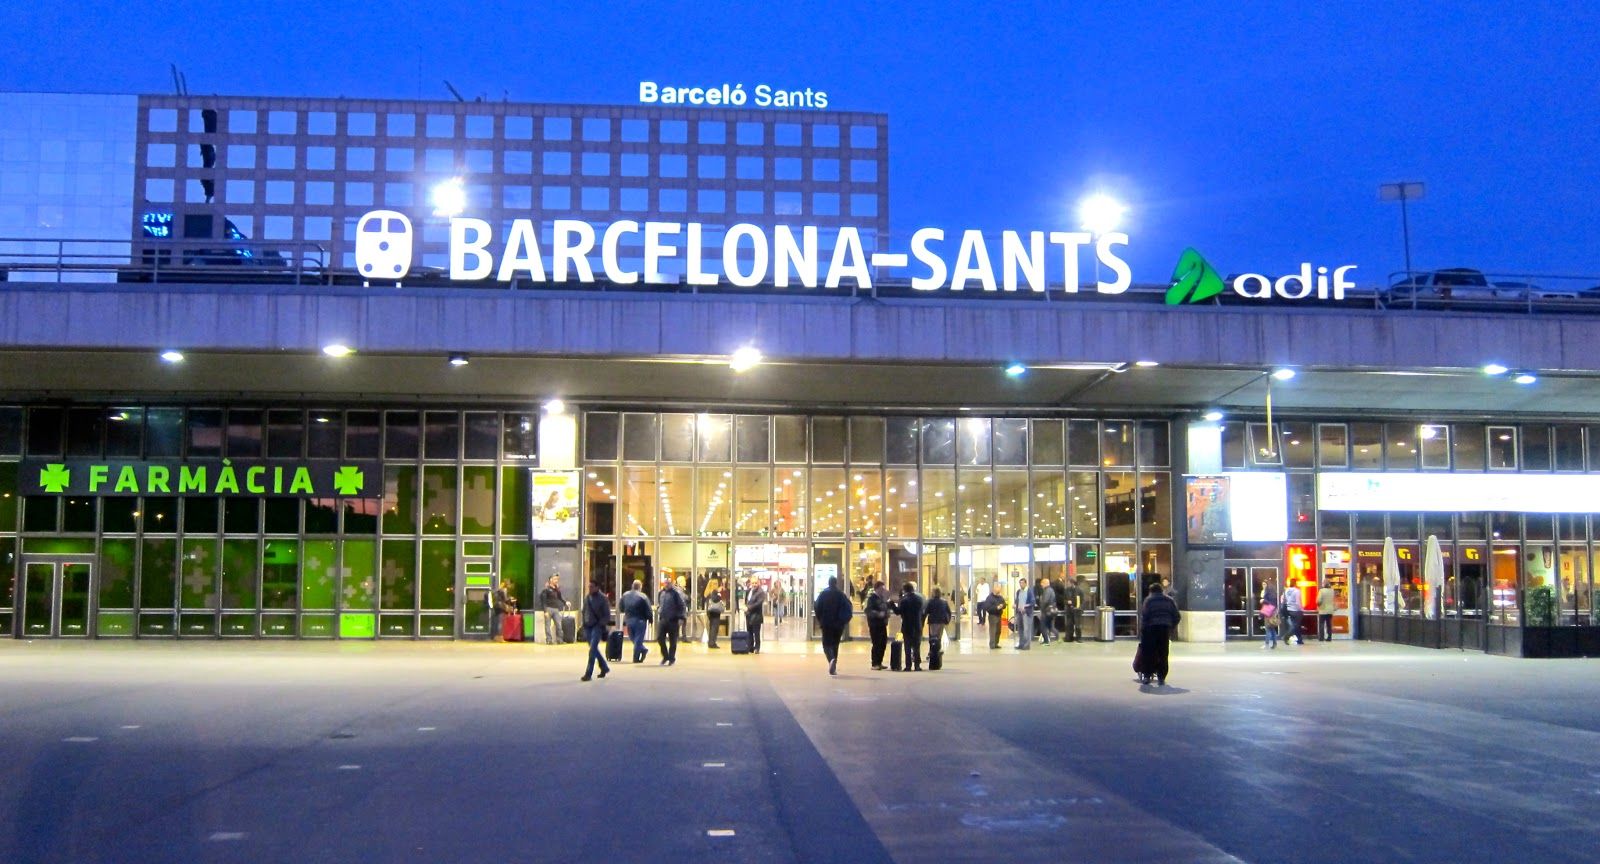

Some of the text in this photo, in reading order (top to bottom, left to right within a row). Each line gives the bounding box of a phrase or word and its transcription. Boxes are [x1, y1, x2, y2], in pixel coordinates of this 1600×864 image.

[639, 82, 828, 108] Barceló Sants
[1233, 262, 1357, 300] adif
[88, 457, 314, 494] FARMÀCIA
